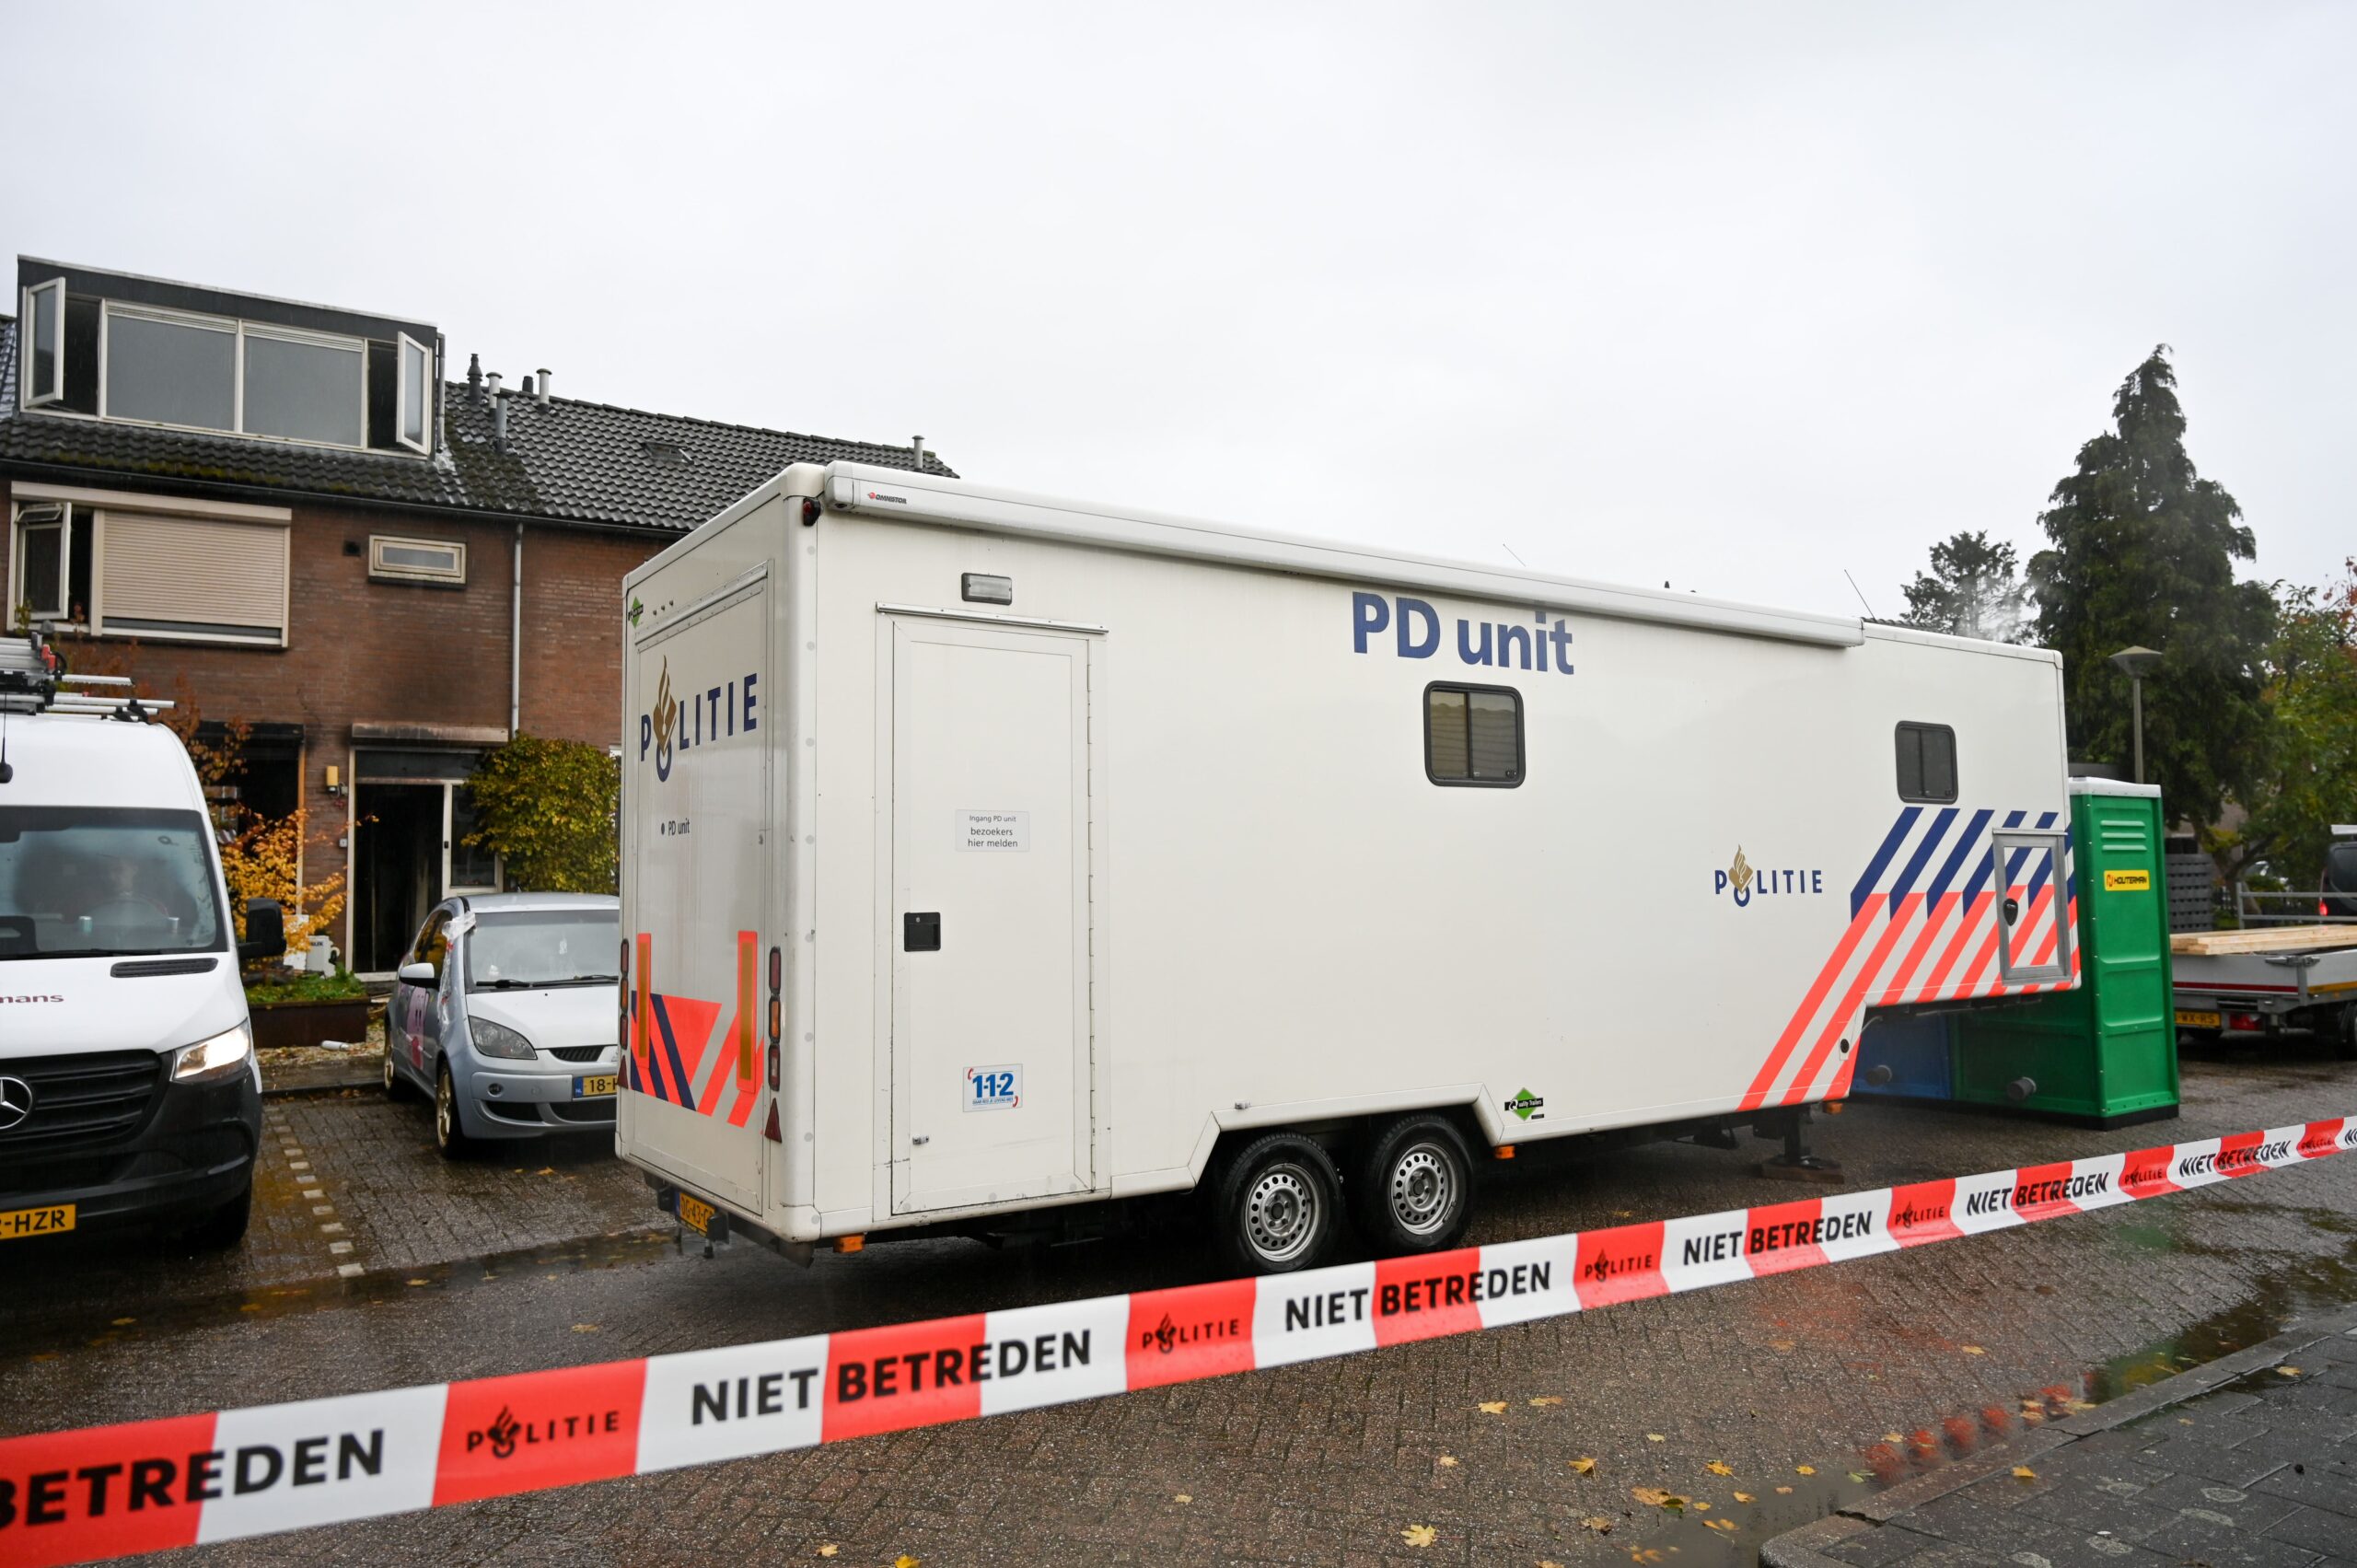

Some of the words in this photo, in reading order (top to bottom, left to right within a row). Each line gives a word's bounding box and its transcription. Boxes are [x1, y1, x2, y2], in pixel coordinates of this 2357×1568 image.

[876, 494, 907, 504] OMNISTOR
[1353, 591, 1441, 659] PD
[1457, 610, 1574, 675] unit
[641, 672, 757, 783] POLITIE
[668, 821, 676, 835] PD
[679, 818, 690, 834] unit
[970, 815, 992, 823] Ingang
[970, 827, 1013, 835] bezoekers
[968, 838, 984, 847] hier
[987, 839, 1017, 847] melden
[1714, 867, 1822, 907] POLITIE
[972, 1073, 1014, 1098] 1-1-2
[0, 1209, 65, 1234] -HZR
[467, 1409, 620, 1458] POLITIE
[691, 1367, 819, 1425] NIET
[838, 1329, 1090, 1403] BETREDEN
[1143, 1317, 1239, 1353] POLITIE
[1286, 1289, 1368, 1332] NIET
[1381, 1260, 1551, 1317] BETREDEN
[1585, 1253, 1653, 1283] POLITIE
[1684, 1231, 1743, 1266] NIET
[1750, 1211, 1873, 1254] BETREDEN
[1895, 1205, 1945, 1228] POLITIE
[1967, 1187, 2013, 1216] NIET
[2015, 1171, 2109, 1207] BETREDEN
[2178, 1153, 2216, 1178] NIET
[2217, 1140, 2291, 1170] BETREDEN
